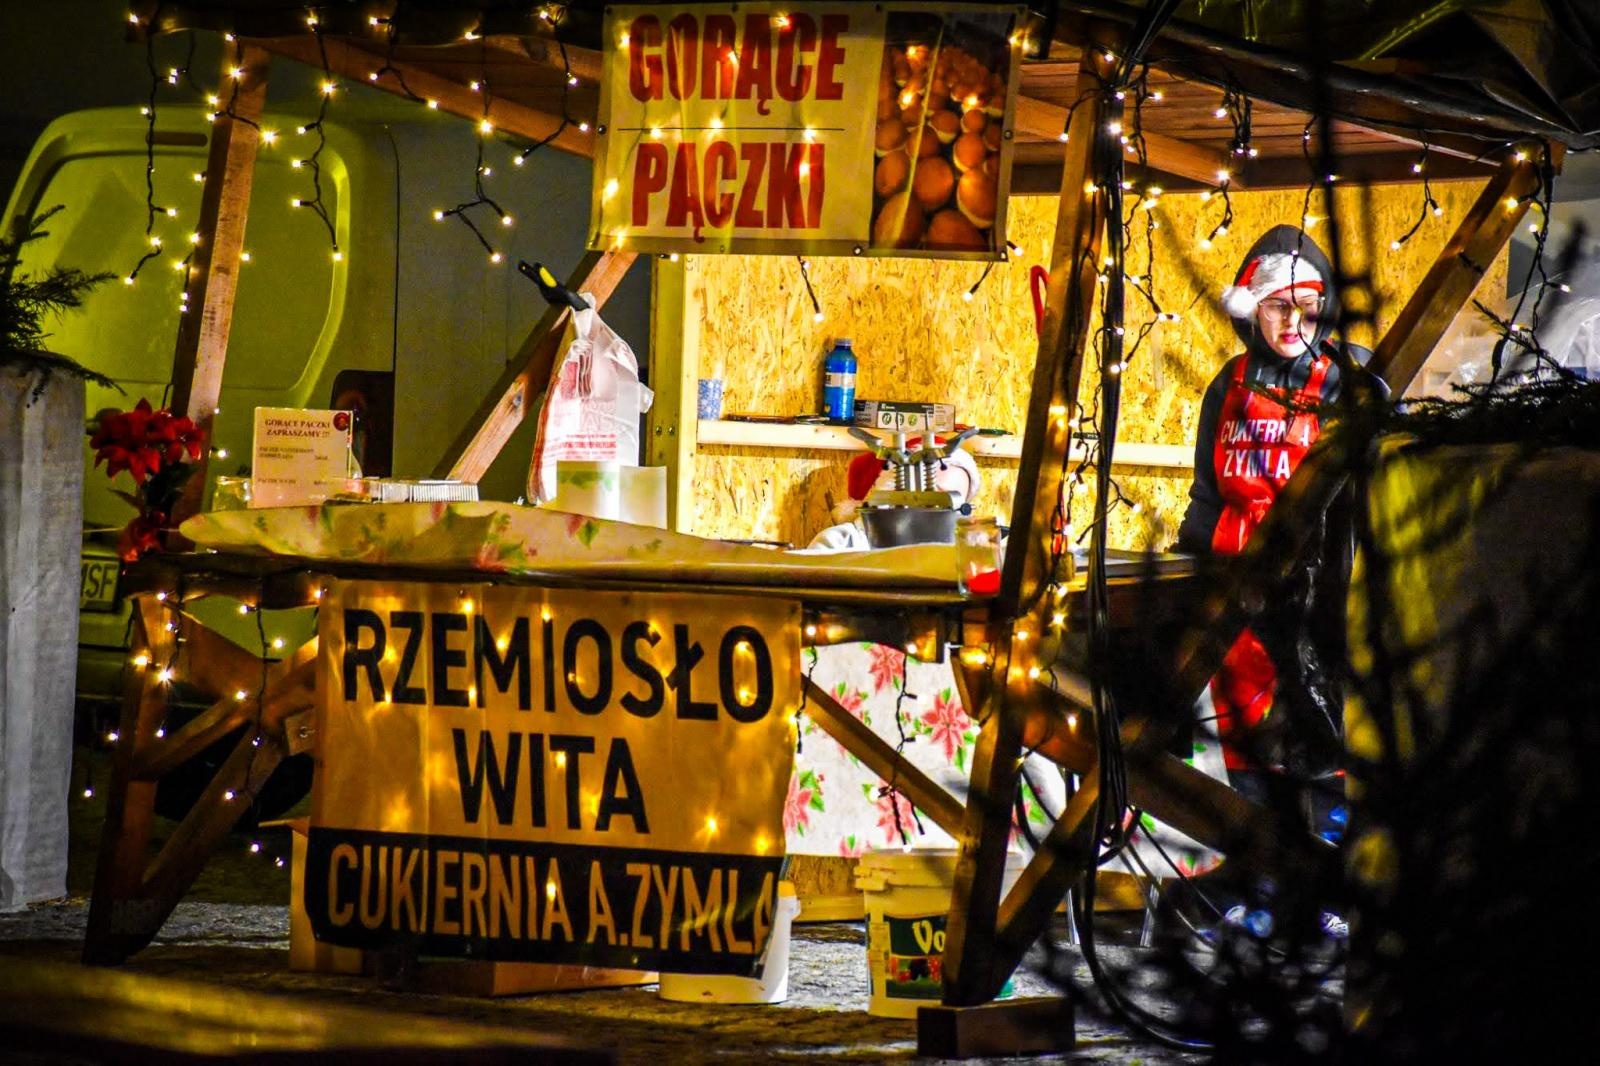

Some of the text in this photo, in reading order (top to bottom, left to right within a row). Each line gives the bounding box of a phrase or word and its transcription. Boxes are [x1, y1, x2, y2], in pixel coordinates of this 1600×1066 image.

[629, 13, 849, 115] GORĄCE
[632, 142, 825, 243] PĄCZKI
[343, 608, 774, 723] RZEMIOSŁO
[452, 728, 649, 834] WITA
[328, 844, 573, 942] CUKIERNIA
